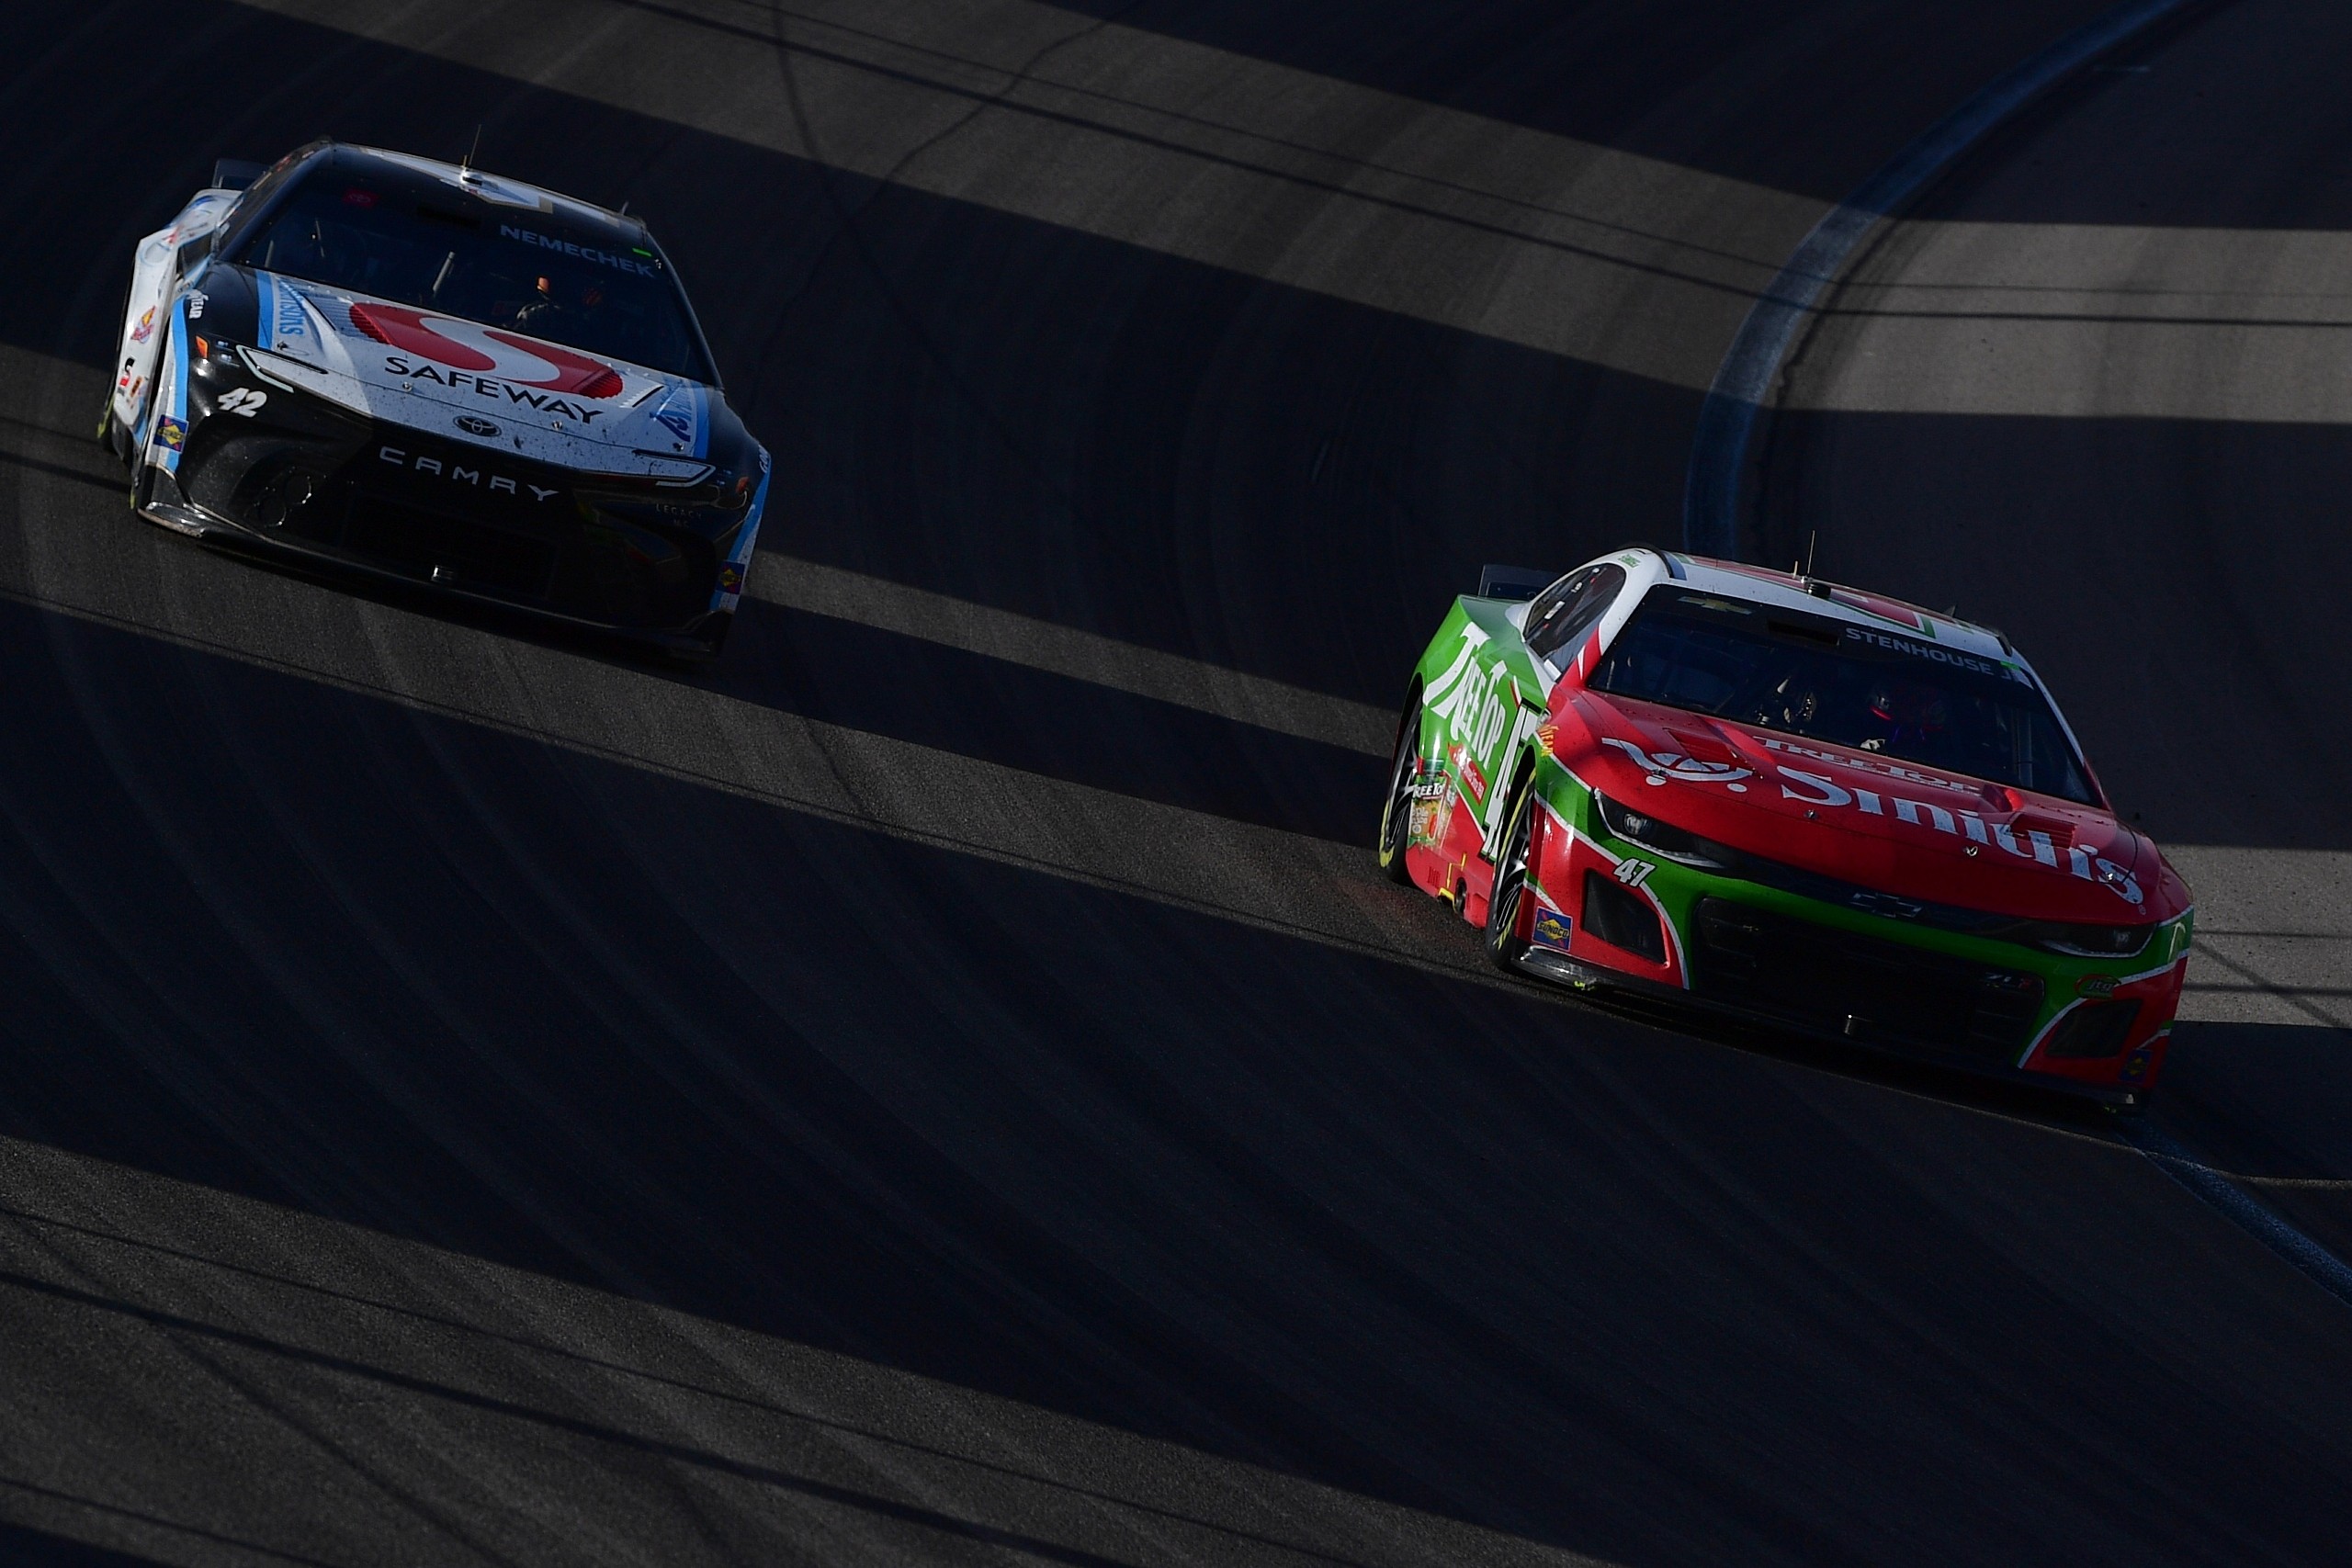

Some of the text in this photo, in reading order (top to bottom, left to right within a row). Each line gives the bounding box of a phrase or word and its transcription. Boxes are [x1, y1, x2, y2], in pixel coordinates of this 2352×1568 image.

[499, 224, 656, 278] NEMECHEK
[217, 387, 267, 418] 42
[384, 356, 604, 424] SAFEWAY
[379, 446, 560, 502] CAMRY
[1845, 626, 1996, 676] STENHOUSE
[1471, 660, 1508, 772] TOP
[1752, 736, 1876, 771] TREE
[1613, 857, 1657, 887] 47
[1536, 922, 1569, 938] SUNOCO
